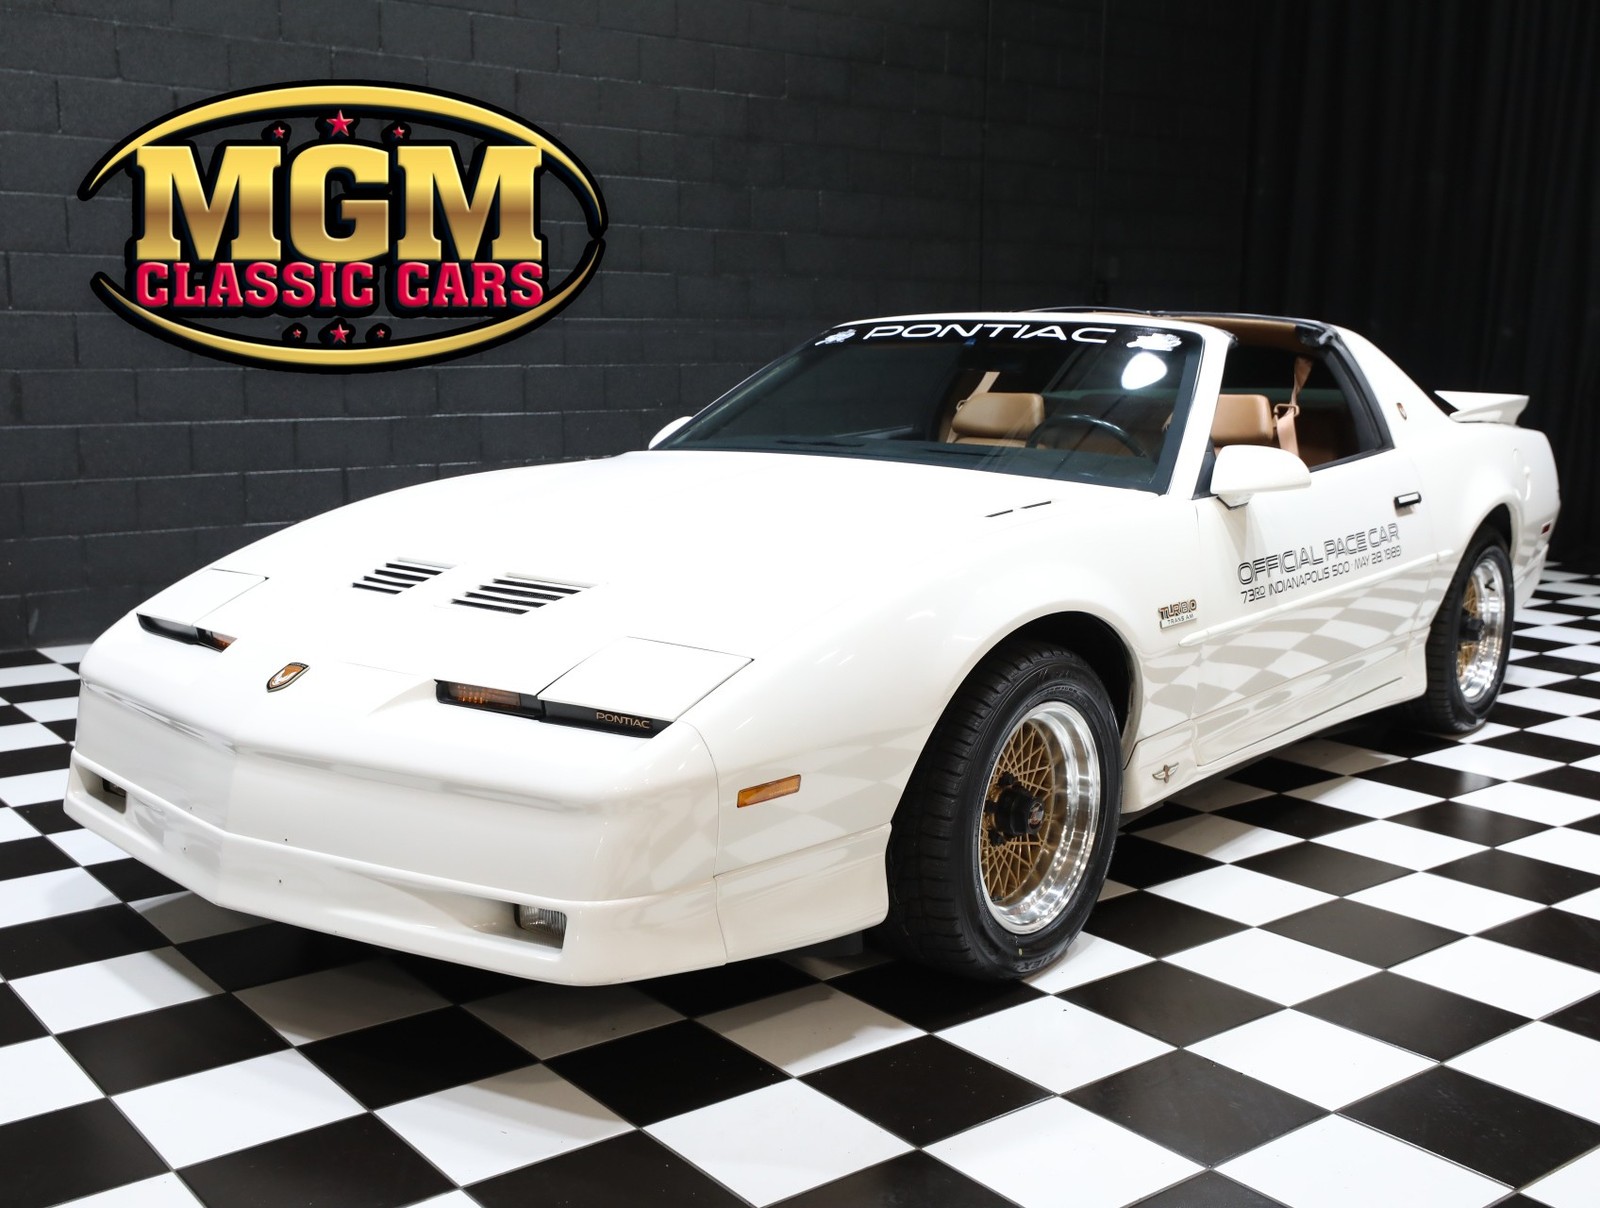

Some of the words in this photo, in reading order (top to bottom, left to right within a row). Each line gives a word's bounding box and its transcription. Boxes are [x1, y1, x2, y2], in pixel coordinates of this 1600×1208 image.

[862, 323, 1116, 344] PONTIAC
[1238, 546, 1324, 585] OFFICIAL
[1324, 531, 1368, 561] PACE
[1368, 522, 1400, 549] CAR
[1241, 585, 1266, 604] 73RD
[1269, 566, 1330, 597] INDIANAPOLIS
[1332, 560, 1350, 577] 500
[1354, 555, 1371, 570] MAY
[1384, 544, 1402, 560] 1989
[1158, 599, 1197, 620] TURBO
[1167, 615, 1185, 625] TRANS
[596, 711, 650, 729] PONTIAC
